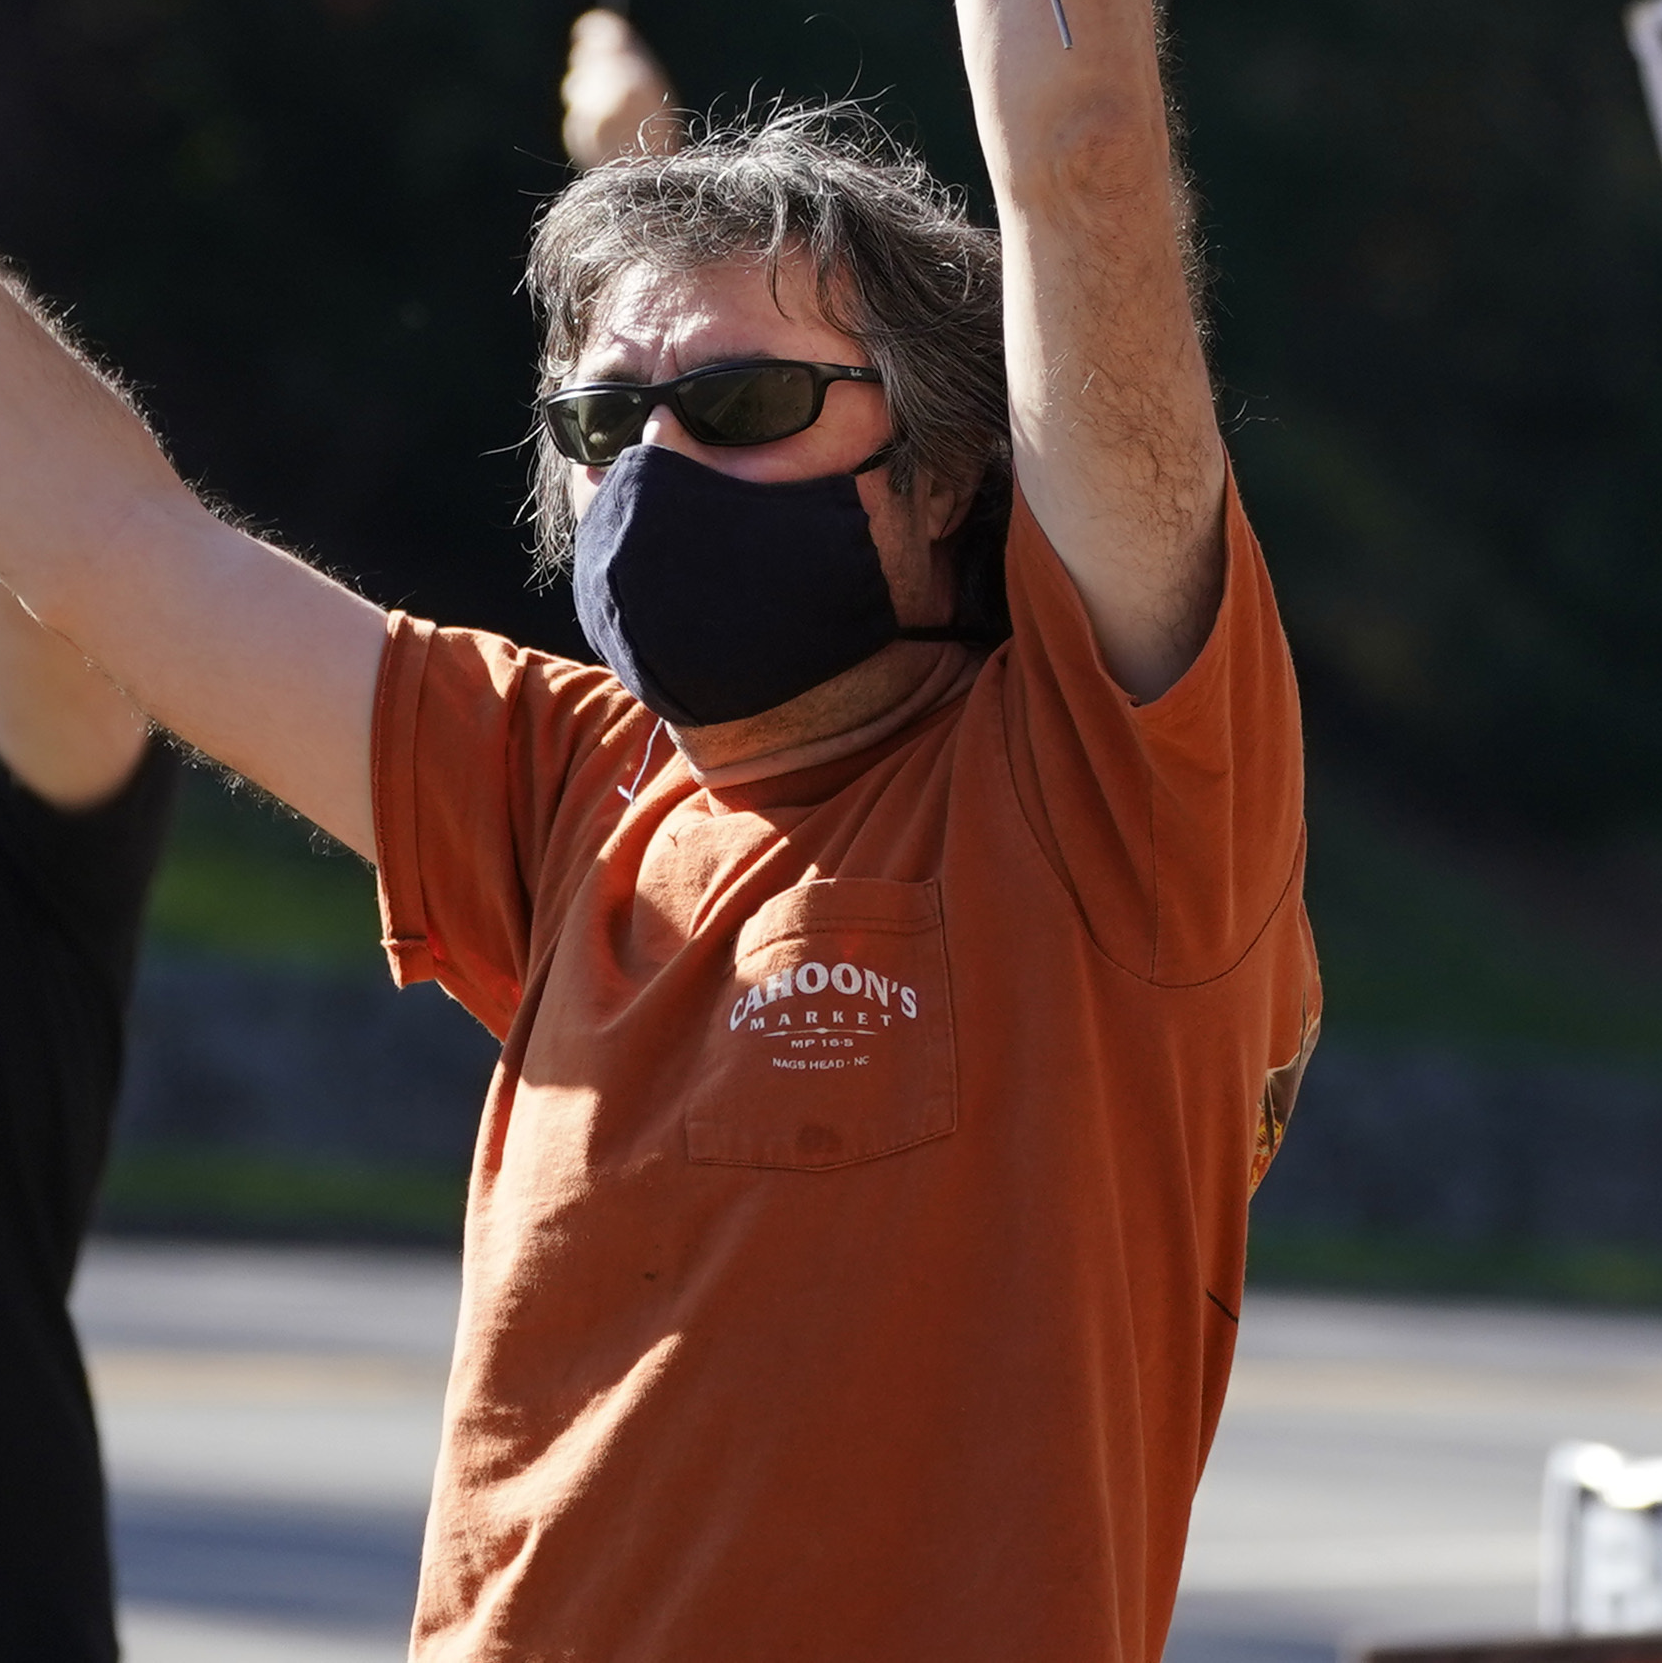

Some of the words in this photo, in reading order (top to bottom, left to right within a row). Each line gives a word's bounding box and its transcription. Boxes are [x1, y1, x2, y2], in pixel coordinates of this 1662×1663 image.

[729, 962, 918, 1031] CAHOON'S
[749, 1010, 892, 1031] MARKET
[790, 1039, 815, 1049] MP
[772, 1057, 806, 1069] NAGS
[809, 1058, 845, 1070] HEAD
[853, 1055, 870, 1066] NC
